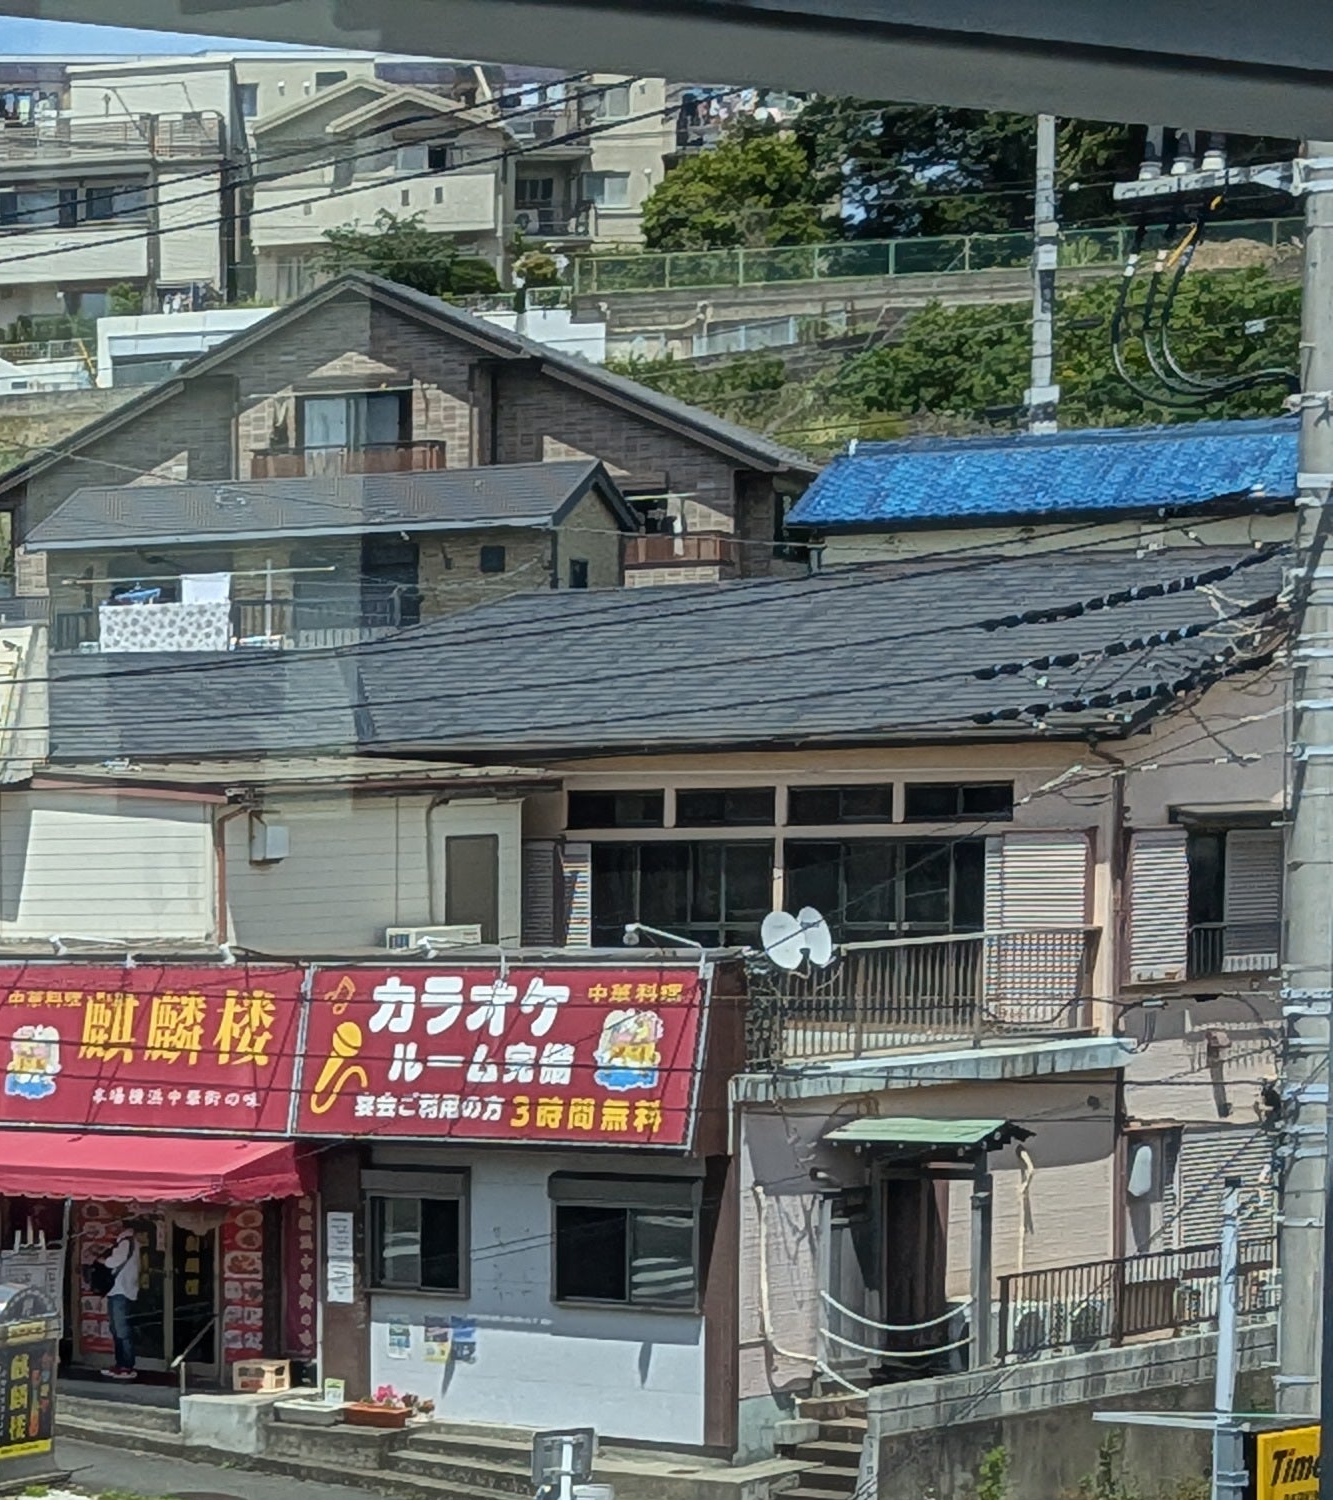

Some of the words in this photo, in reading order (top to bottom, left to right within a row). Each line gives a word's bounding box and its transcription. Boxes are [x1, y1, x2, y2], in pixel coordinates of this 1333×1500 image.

[8, 990, 84, 1009] 中華料理
[368, 975, 571, 1037] カラオケ
[587, 983, 684, 1004] 中華料理
[77, 989, 278, 1067] 麒麟楼
[387, 1041, 576, 1086] ルーム完備
[1270, 1447, 1321, 1487] Time
